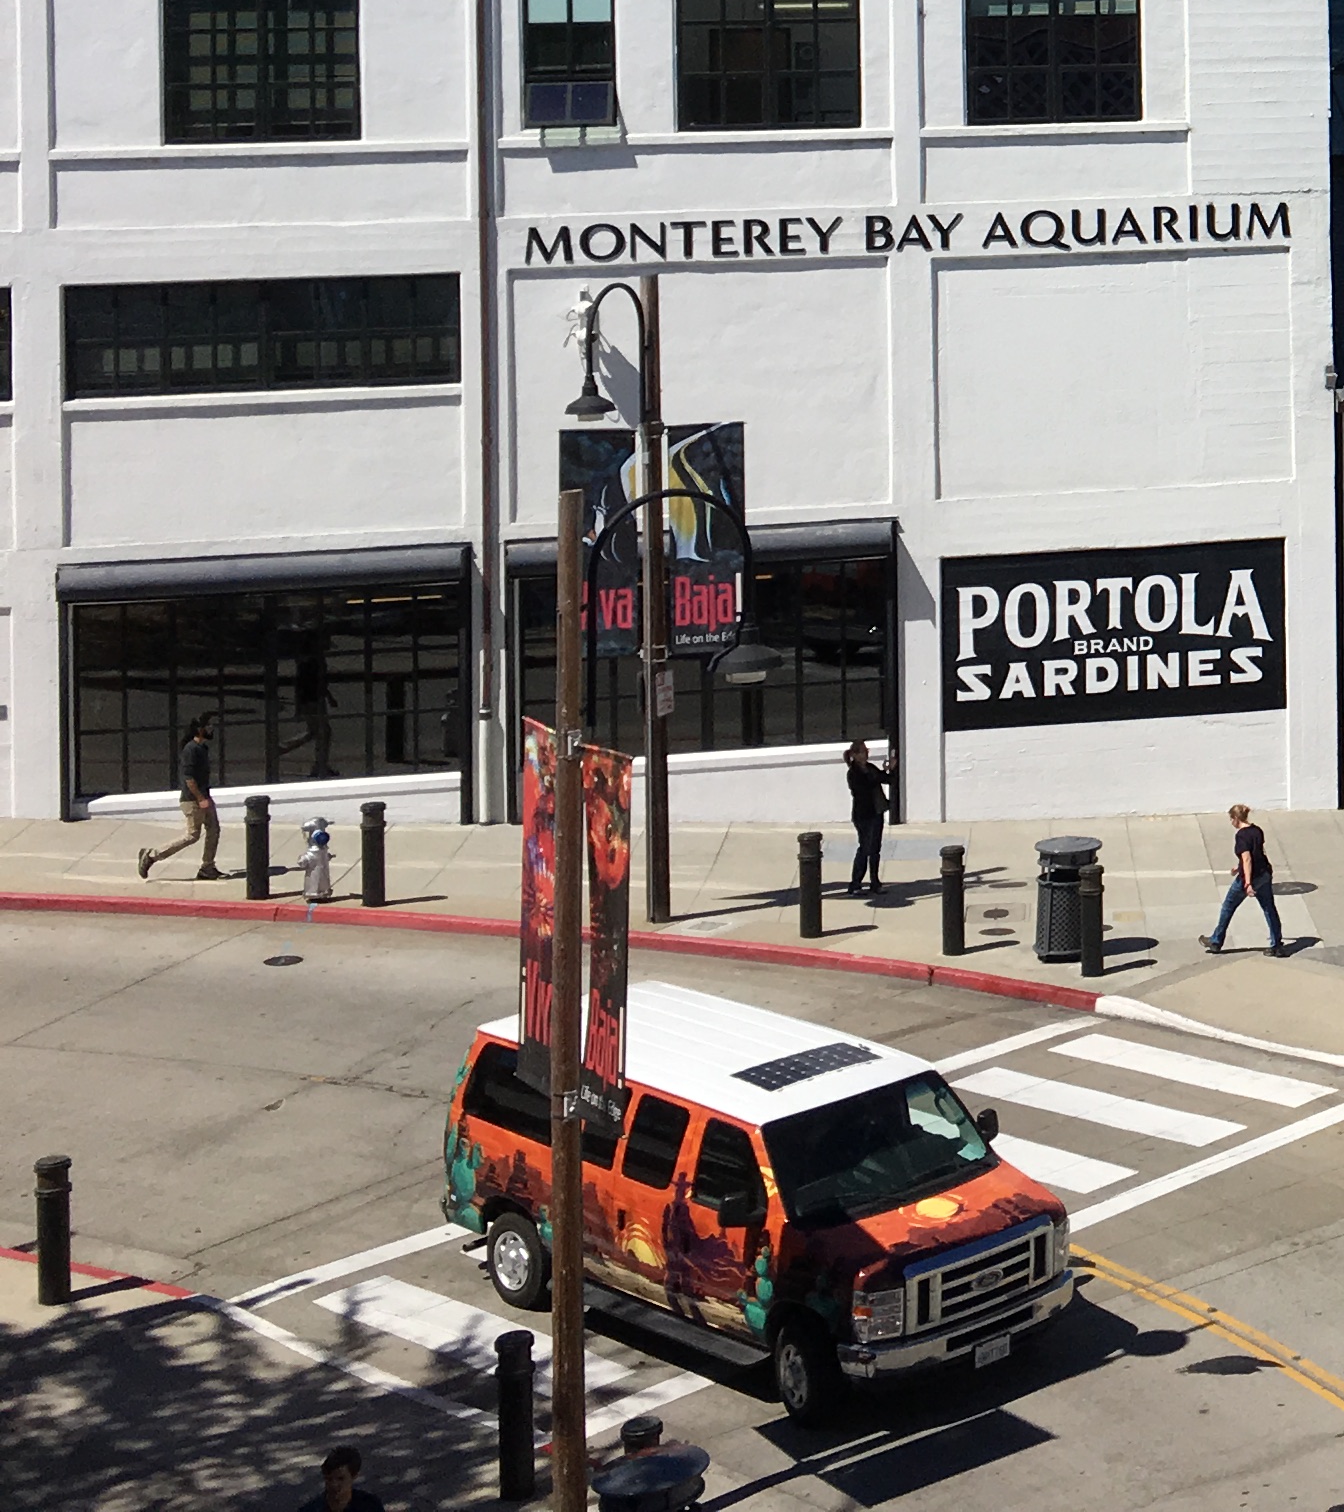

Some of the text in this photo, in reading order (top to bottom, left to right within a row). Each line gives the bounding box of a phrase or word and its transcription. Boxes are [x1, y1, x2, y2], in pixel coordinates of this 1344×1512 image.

[525, 202, 1291, 265] MONTEREY BAY AQUARIUM
[674, 572, 742, 632] Baja!
[956, 568, 1274, 662] PORTOLA
[675, 633, 690, 645] Life
[692, 634, 704, 644] on
[706, 632, 720, 643] the
[1073, 636, 1154, 656] BRAND
[956, 646, 1263, 702] SARDINES
